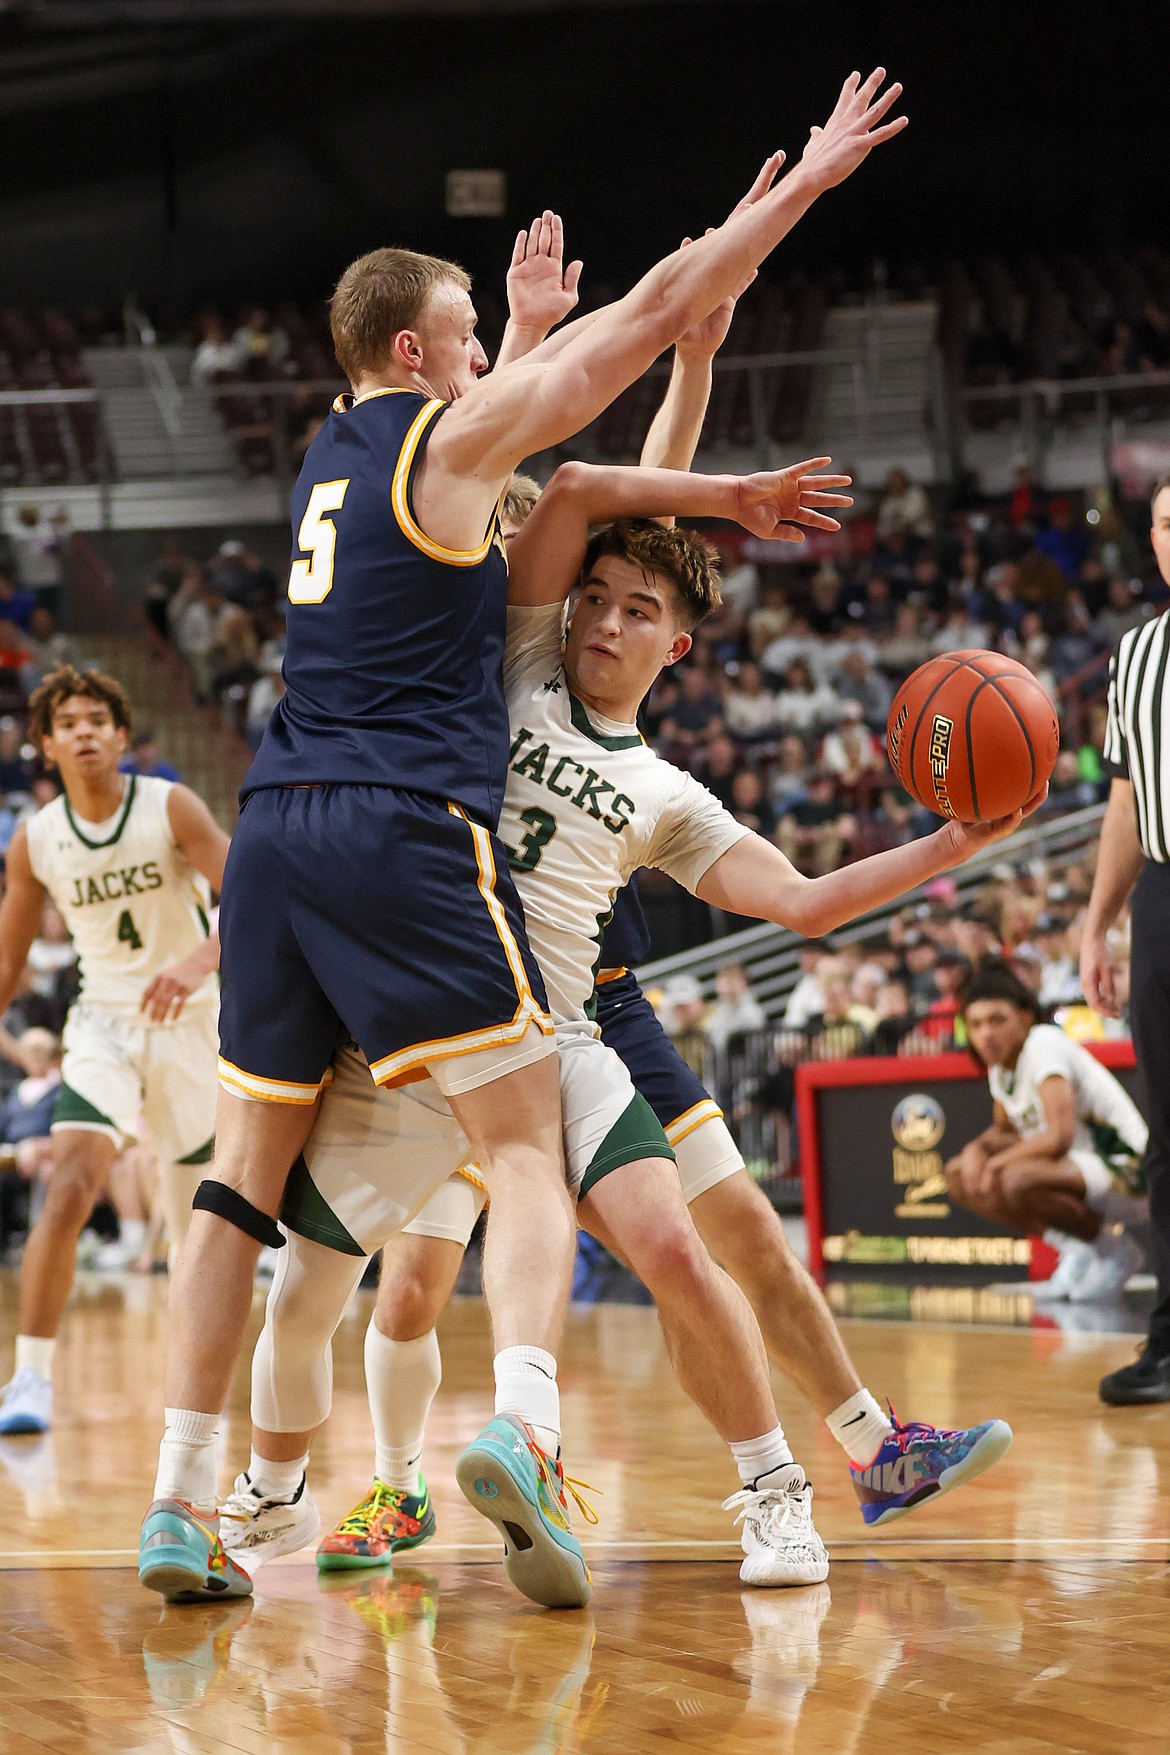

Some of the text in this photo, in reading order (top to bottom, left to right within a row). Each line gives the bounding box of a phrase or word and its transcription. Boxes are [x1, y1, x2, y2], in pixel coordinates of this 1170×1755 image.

[287, 478, 350, 605] 5
[510, 727, 636, 835] JACKS
[503, 805, 558, 872] 3
[71, 862, 163, 907] JACKS
[118, 909, 143, 950] 4
[855, 1454, 924, 1494] NIKE
